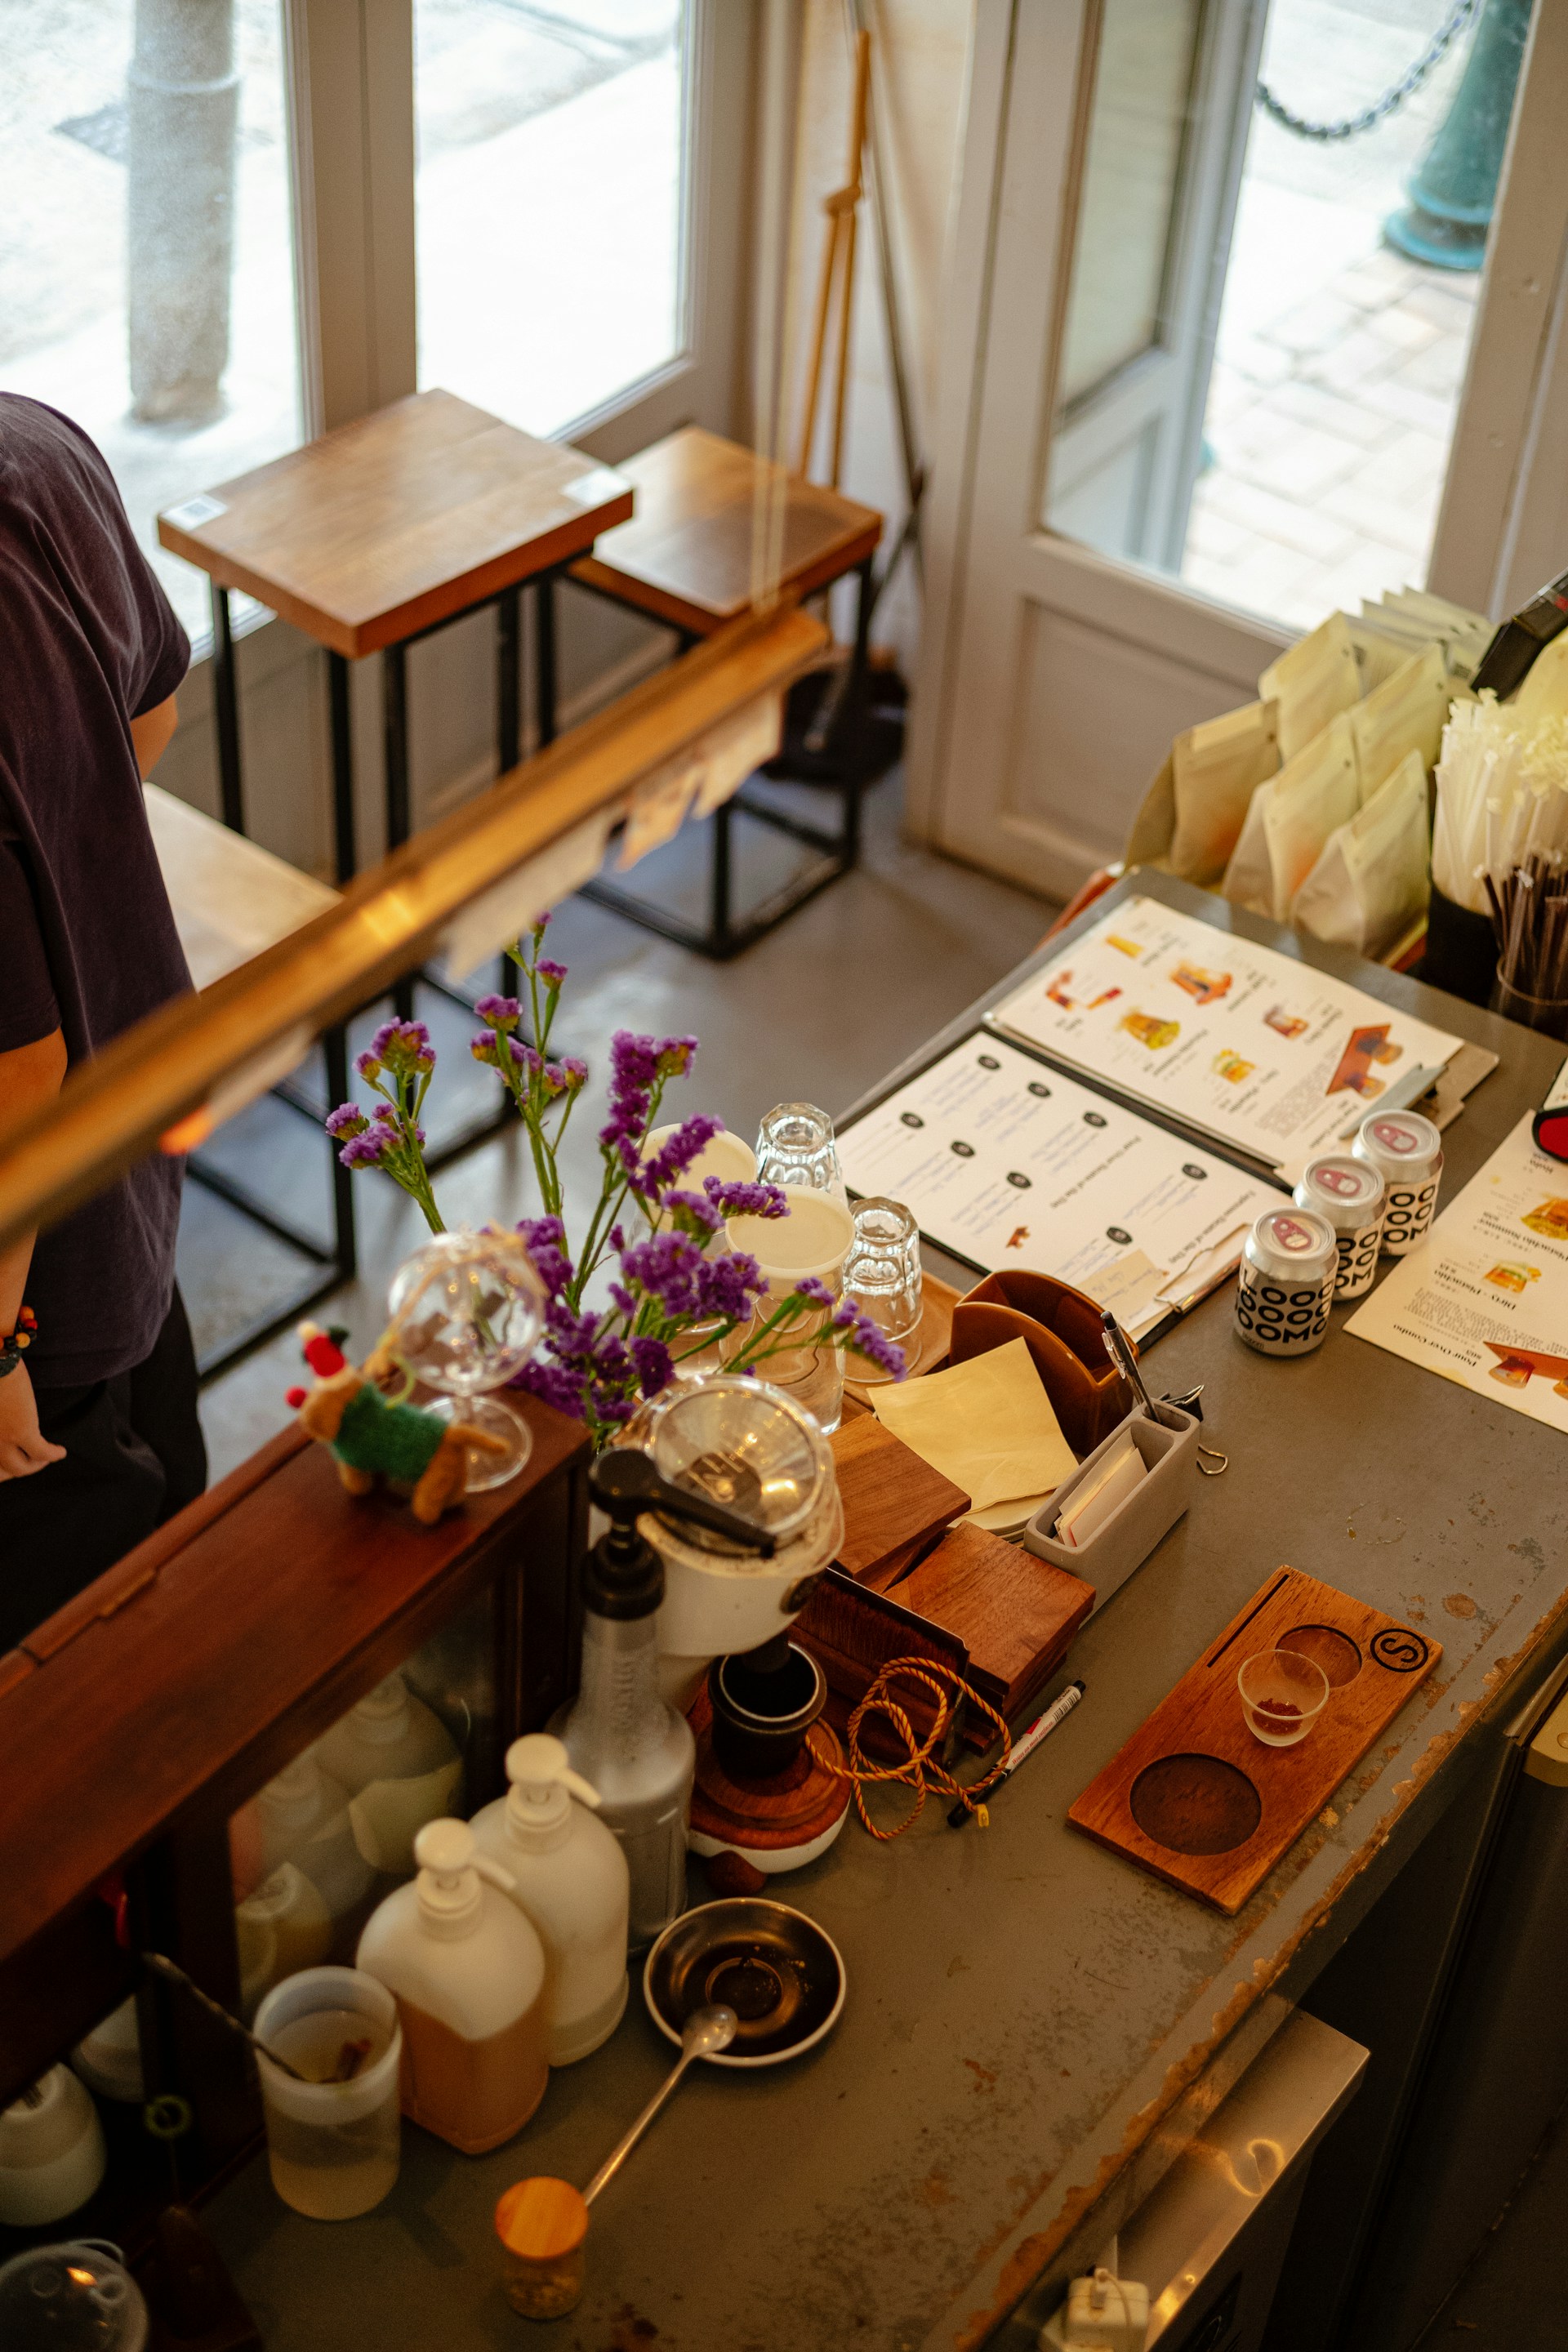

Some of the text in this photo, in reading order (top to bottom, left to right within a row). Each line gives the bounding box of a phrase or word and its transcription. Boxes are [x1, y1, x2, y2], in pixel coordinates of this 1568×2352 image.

[1434, 1270, 1481, 1295] Pistachio
[1491, 1294, 1517, 1311] Dirty
[1393, 1324, 1428, 1343] Combo
[1428, 1340, 1451, 1355] Over
[1453, 1352, 1477, 1367] Pour
[1012, 1753, 1024, 1765] Writes
